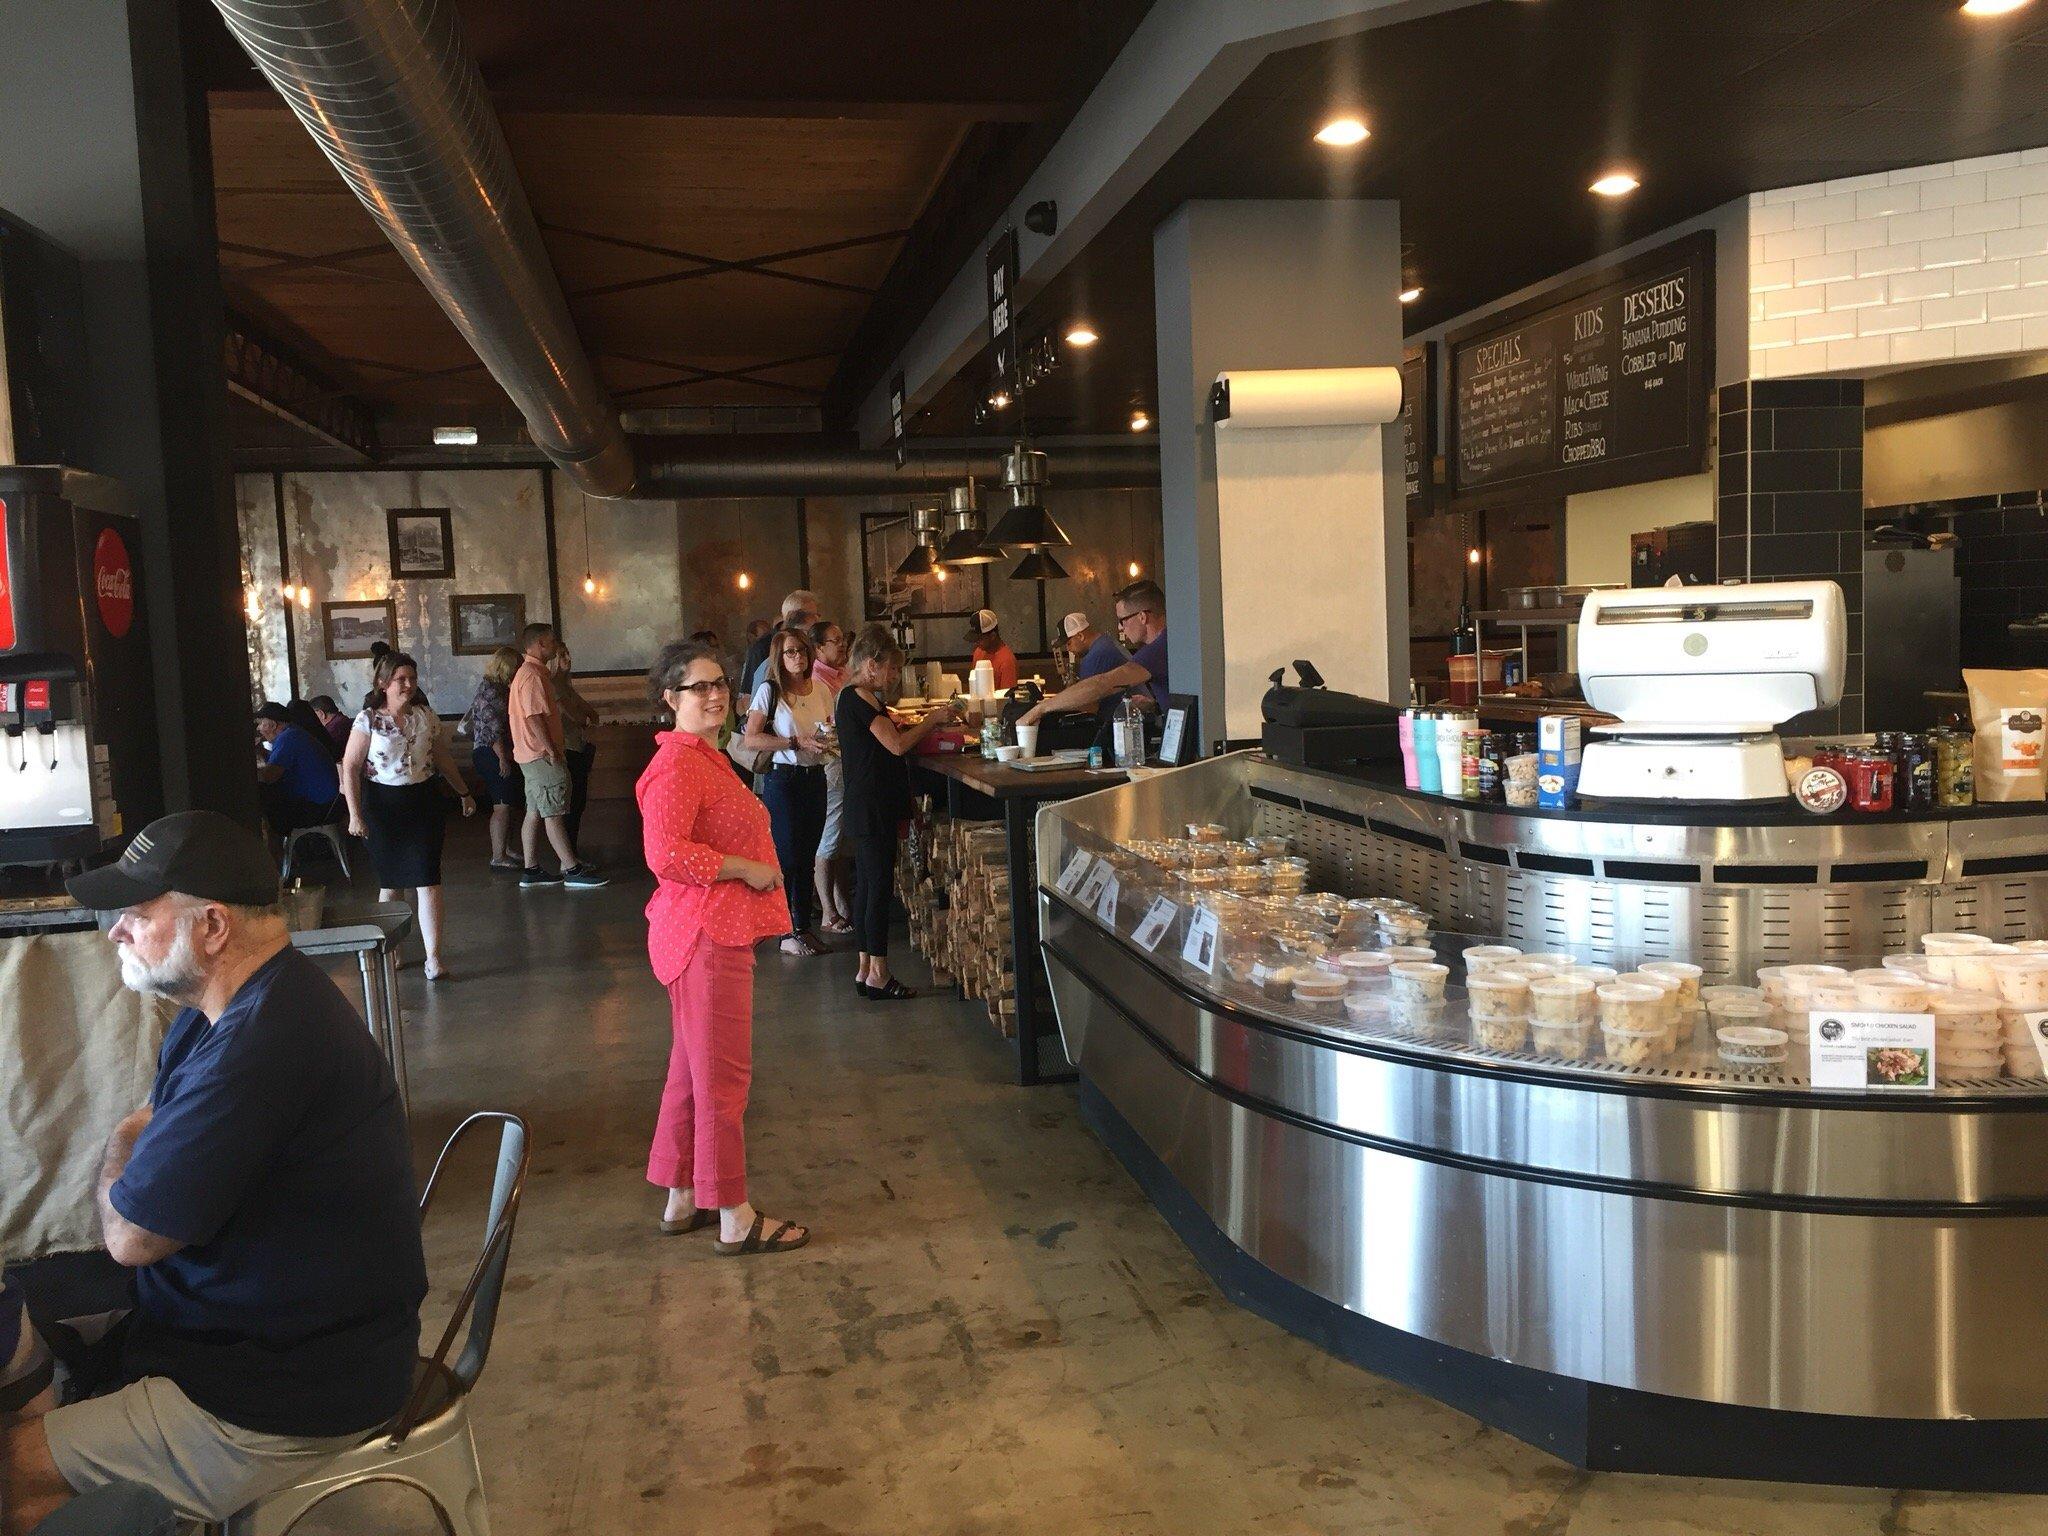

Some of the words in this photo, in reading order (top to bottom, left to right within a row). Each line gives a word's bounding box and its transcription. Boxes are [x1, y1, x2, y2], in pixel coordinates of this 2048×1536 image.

[1623, 277, 1685, 324] DESSERTS
[1574, 306, 1604, 341] KIDS
[1622, 326, 1651, 350] BANANA
[1651, 316, 1686, 342] PUDDING
[1476, 335, 1521, 374] SPECIALS
[1621, 351, 1657, 375] COBBLER
[1668, 341, 1686, 364] DAY
[1584, 390, 1609, 411] CHEESE
[1565, 420, 1583, 440] RIBS
